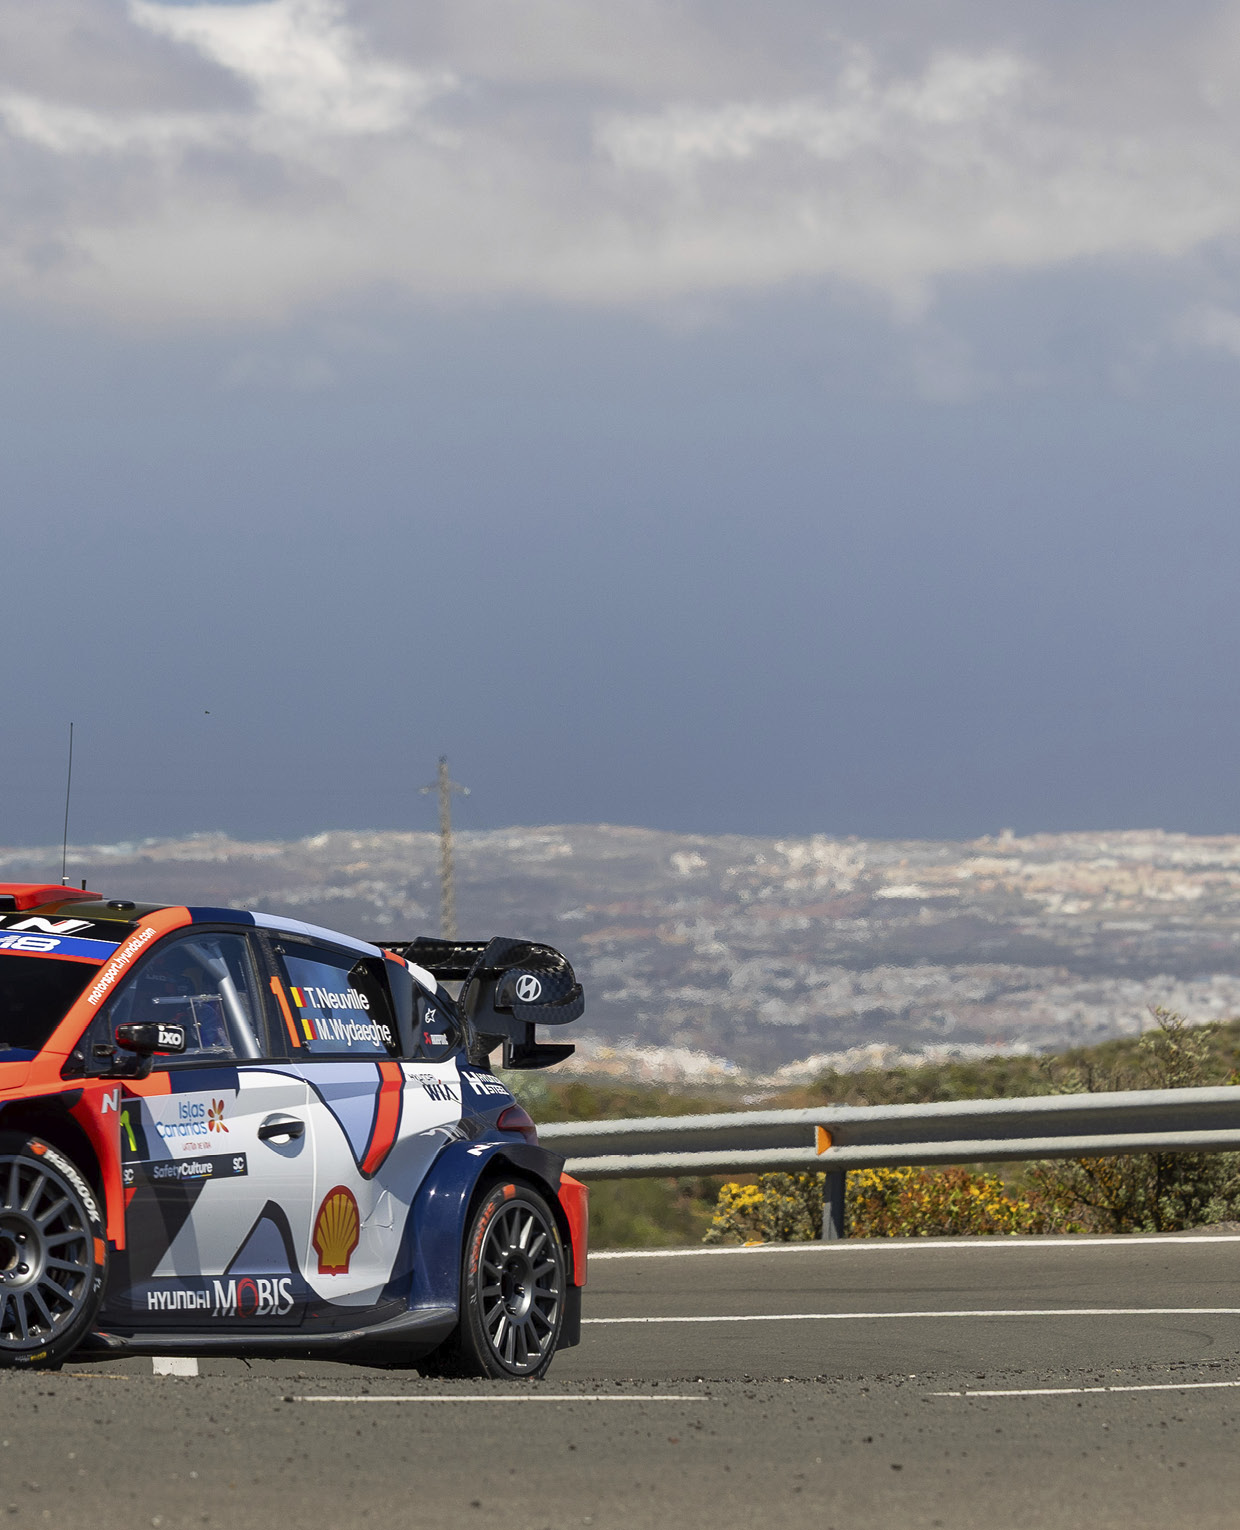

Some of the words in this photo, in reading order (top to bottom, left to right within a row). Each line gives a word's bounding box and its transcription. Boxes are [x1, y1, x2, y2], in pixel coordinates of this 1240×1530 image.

[87, 927, 157, 1006] motorsport.hyundai.com
[303, 987, 370, 1011] T.Neuville
[269, 975, 302, 1048] 1
[315, 1018, 392, 1047] M.Wydaeghe
[422, 1083, 460, 1101] WIA
[178, 1100, 205, 1119] Islas
[155, 1118, 208, 1139] Canarias
[153, 1161, 213, 1180] SafetyCulture
[147, 1290, 210, 1310] HYUNDAI
[212, 1278, 295, 1318] MOBIS
